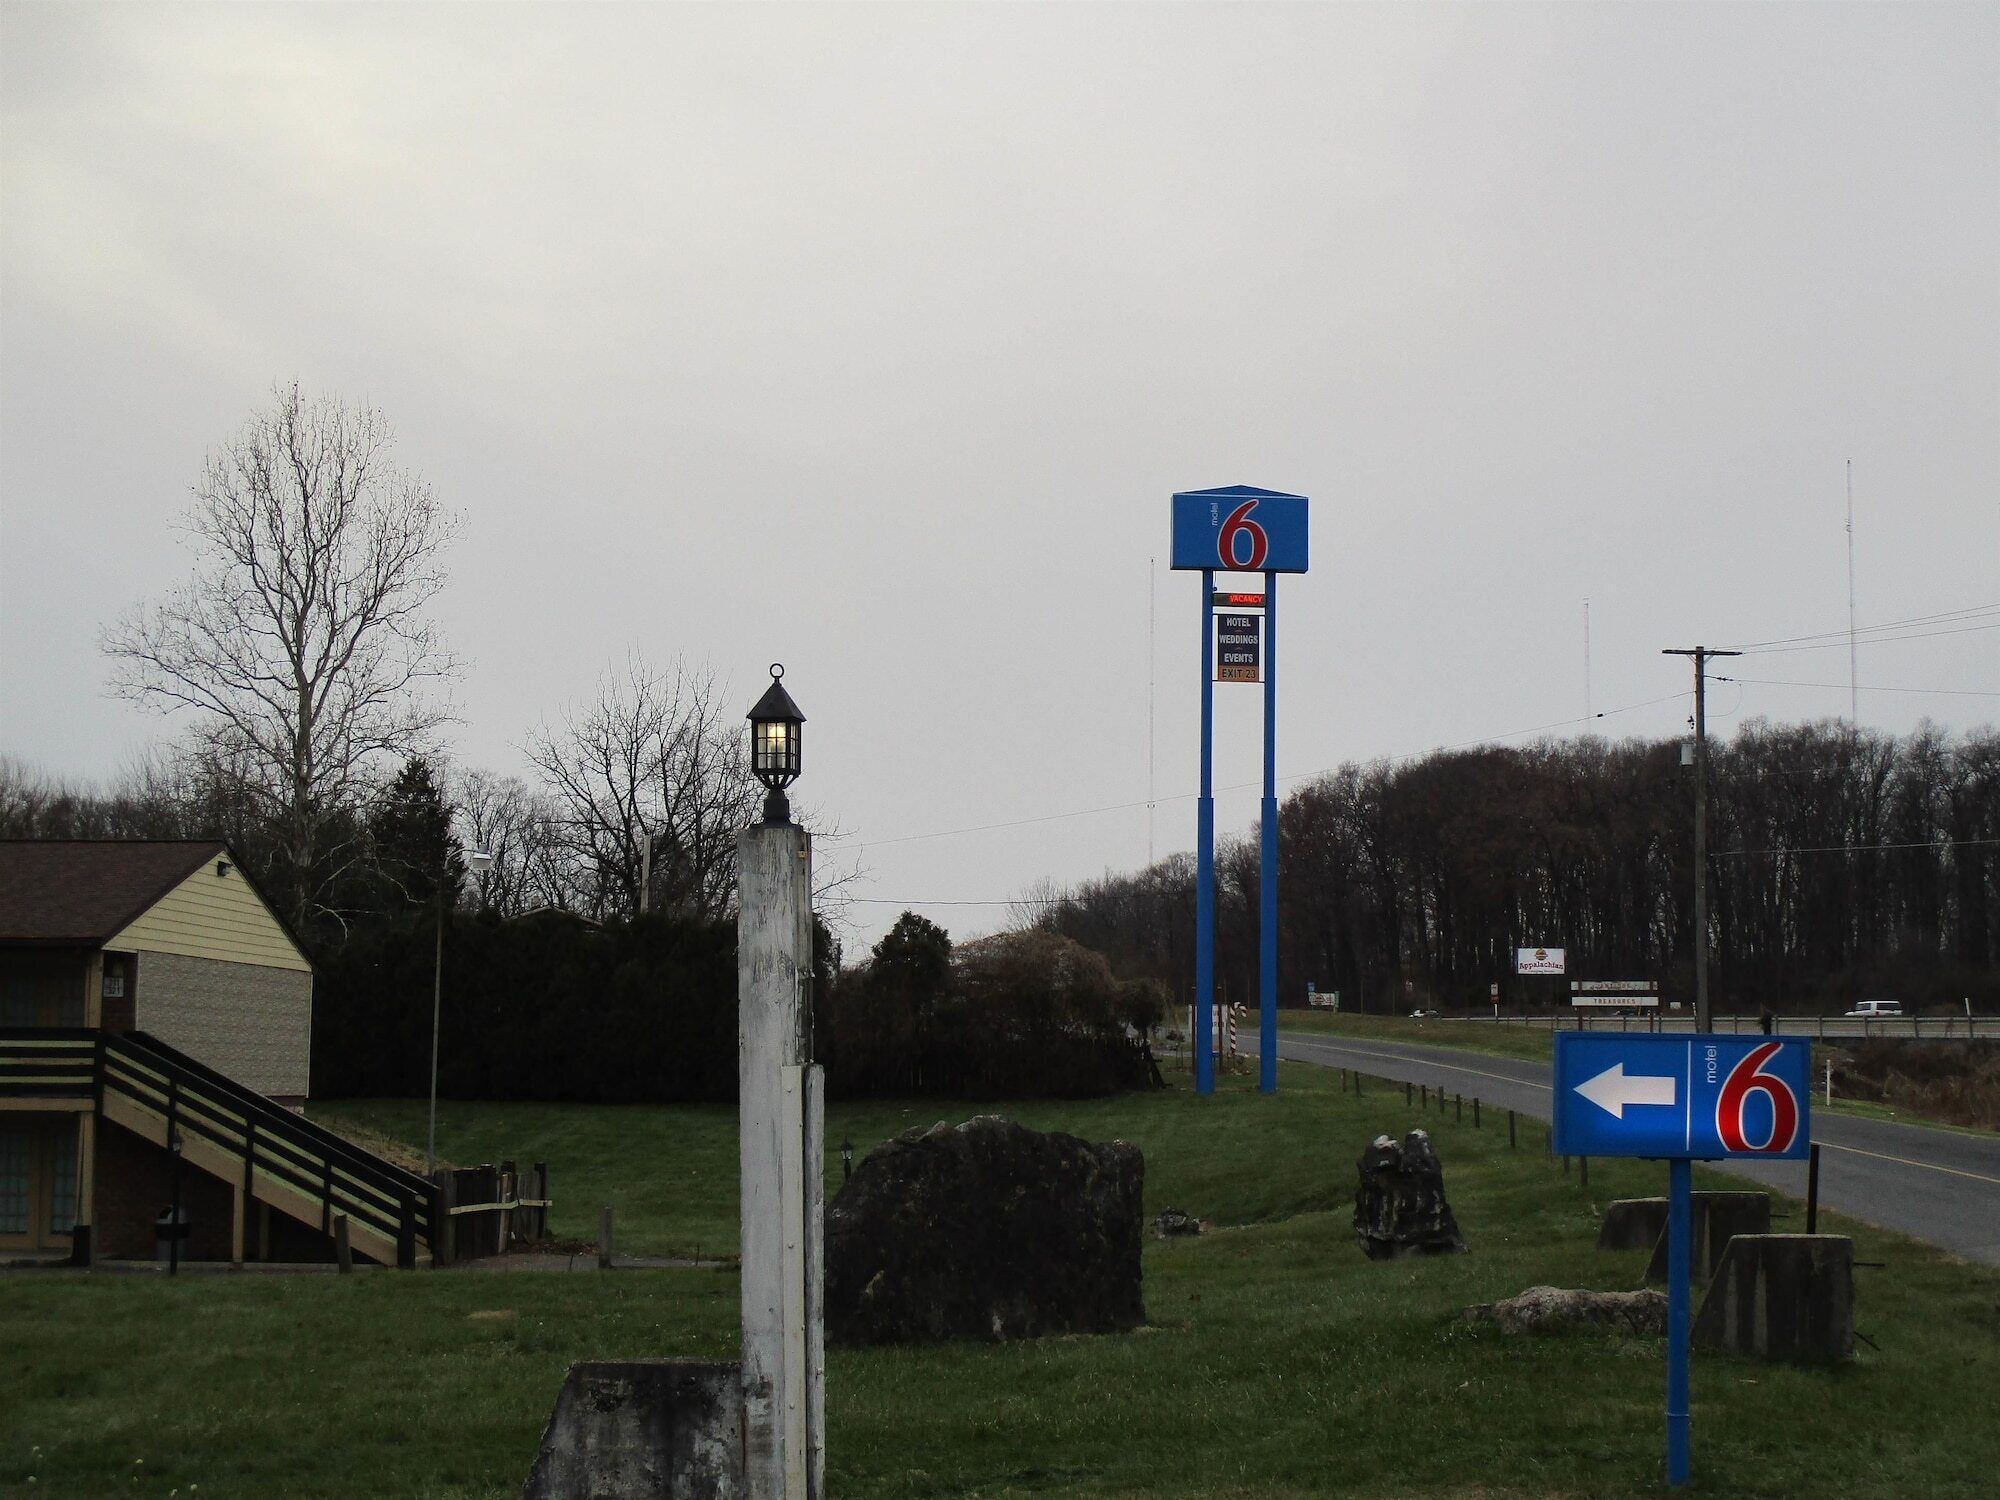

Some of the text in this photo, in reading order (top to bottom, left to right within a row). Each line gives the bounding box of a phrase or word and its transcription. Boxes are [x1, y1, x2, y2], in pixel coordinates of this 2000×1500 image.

[1210, 499, 1268, 568] motel 6
[1230, 595, 1262, 603] VACANCY
[1219, 634, 1259, 645] WEDDINGS
[1224, 653, 1254, 663] EVENTS
[1222, 668, 1256, 679] EXIT 23
[1519, 961, 1564, 970] Appalachian
[1705, 1042, 1799, 1153] motel 6
